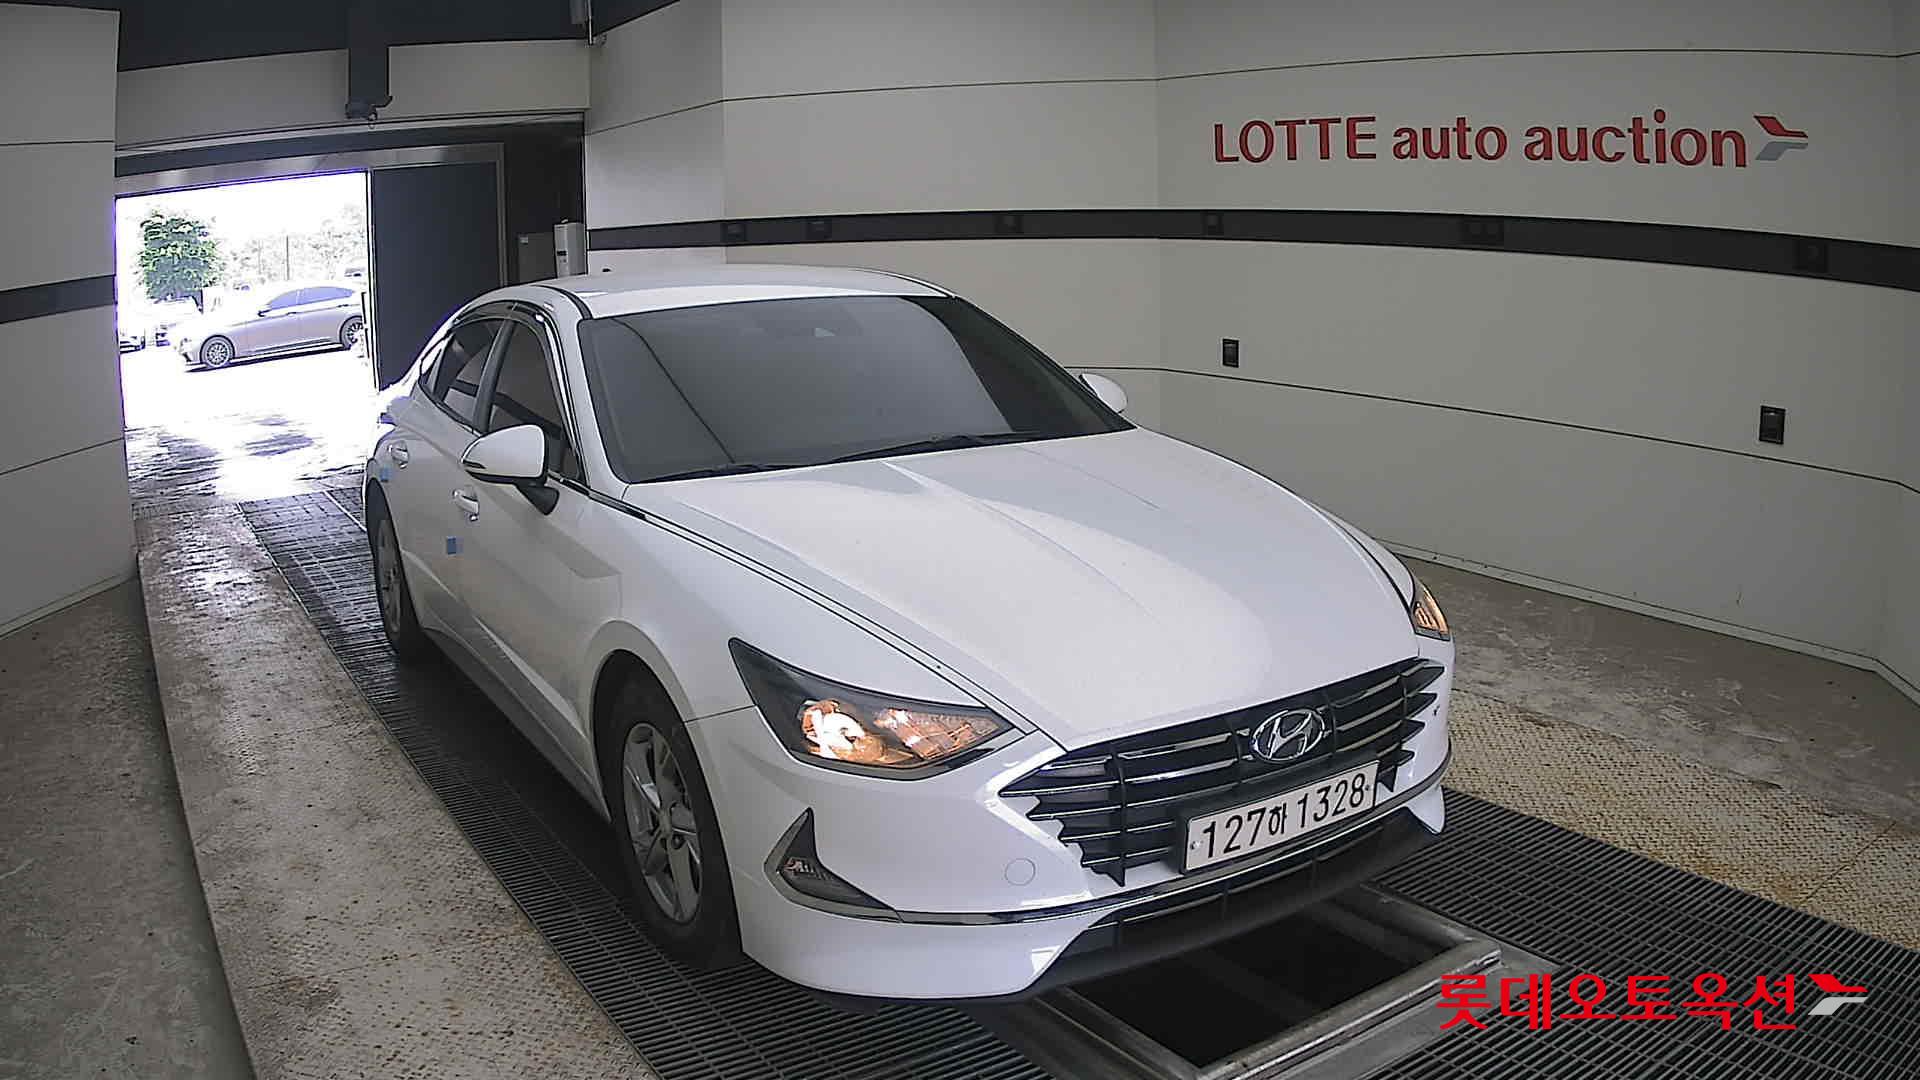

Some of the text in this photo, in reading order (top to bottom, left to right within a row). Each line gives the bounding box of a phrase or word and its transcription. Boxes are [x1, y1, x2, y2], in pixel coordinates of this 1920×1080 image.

[1213, 109, 1748, 168] LOTTE auto auction
[1203, 773, 1366, 858] 127하 1328
